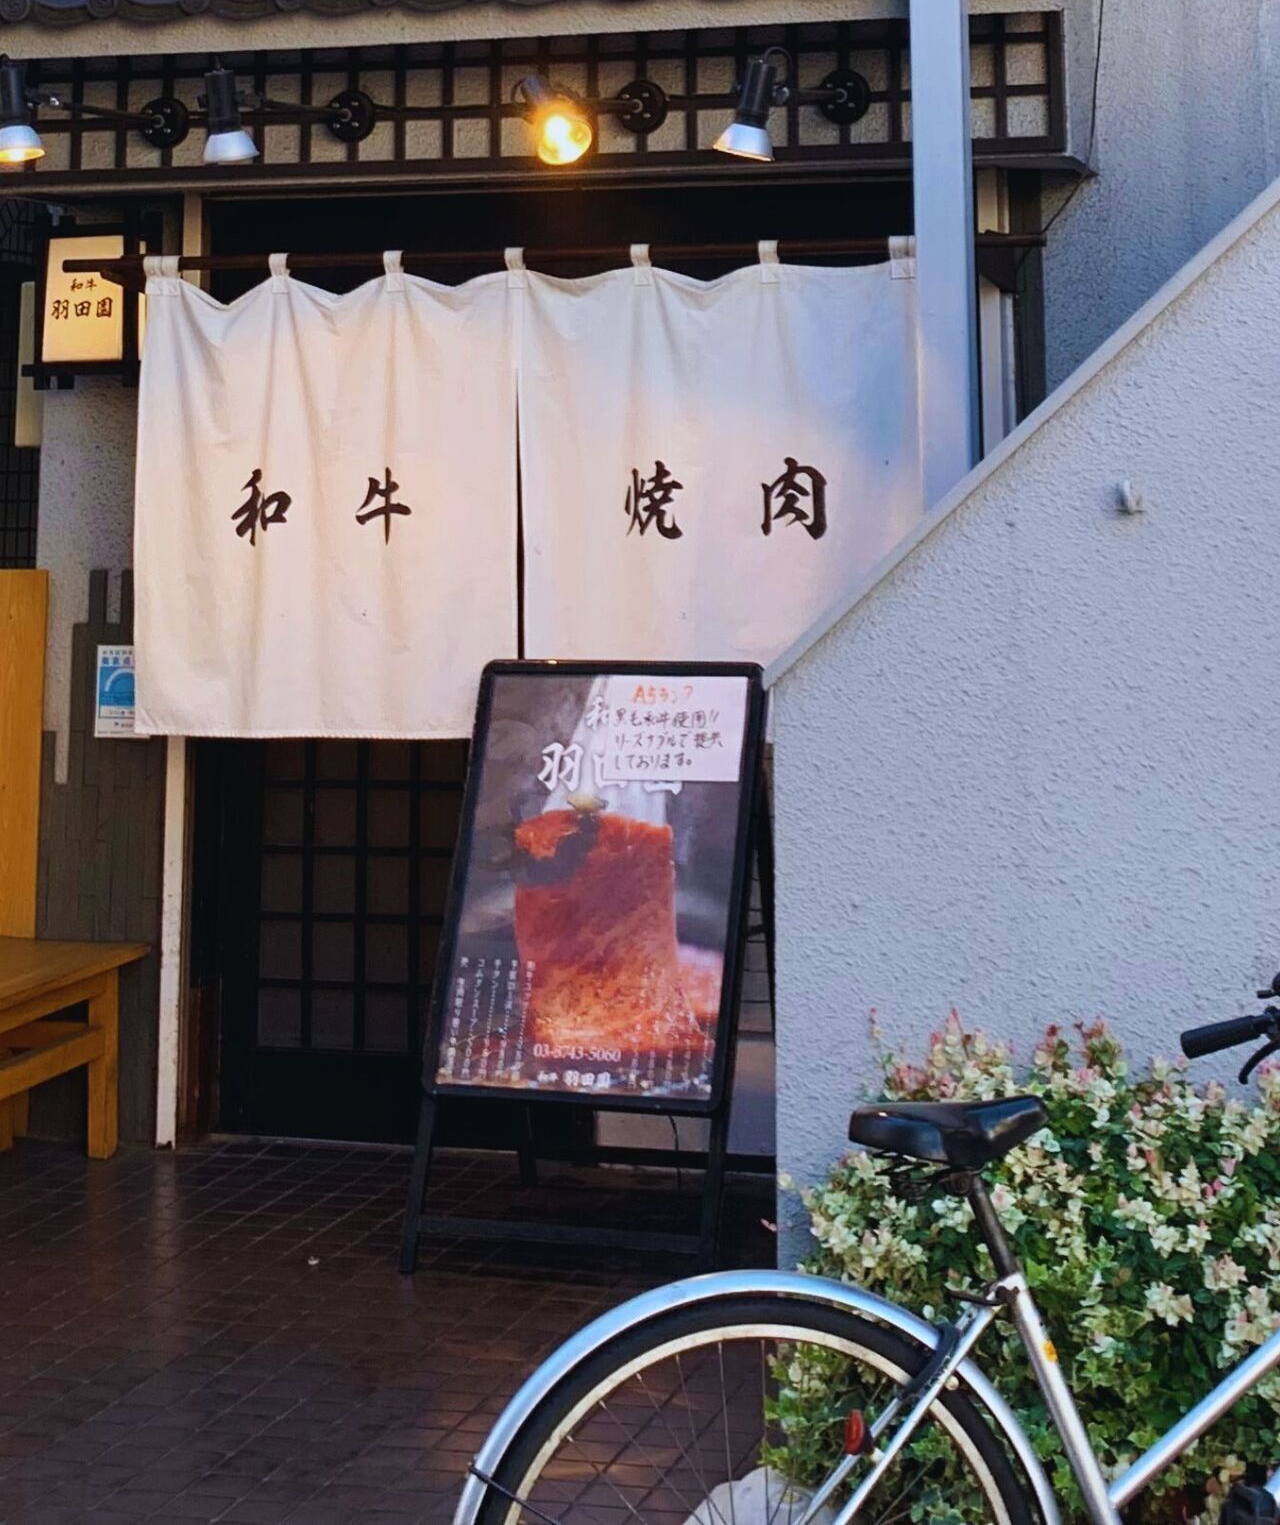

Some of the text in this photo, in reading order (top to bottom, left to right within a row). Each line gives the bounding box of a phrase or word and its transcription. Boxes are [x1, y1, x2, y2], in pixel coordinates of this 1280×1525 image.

[70, 277, 97, 292] 和牛
[51, 297, 113, 319] 羽田園
[231, 456, 828, 546] 和牛 焼肉
